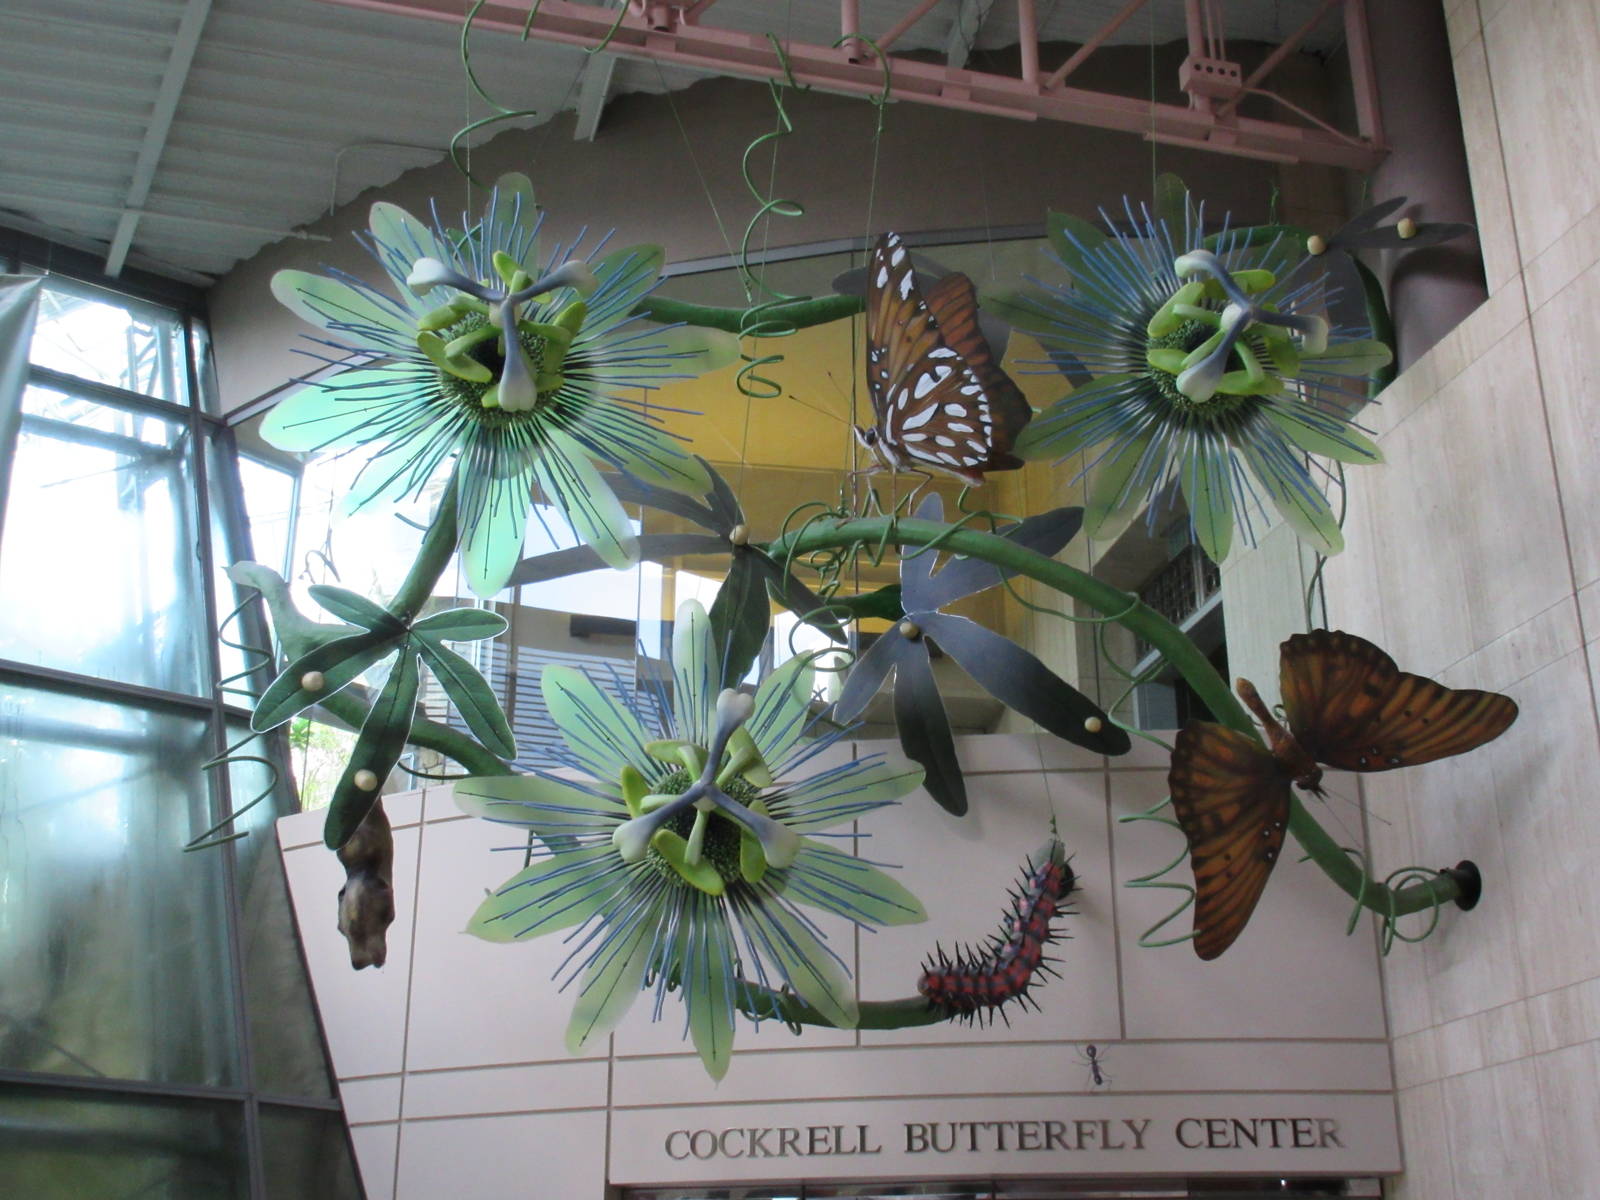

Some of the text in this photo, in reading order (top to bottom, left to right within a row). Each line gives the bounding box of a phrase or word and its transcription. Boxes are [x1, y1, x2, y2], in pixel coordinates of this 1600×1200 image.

[665, 1117, 1347, 1161] COCKRELL BUTTERFLY CENTER
